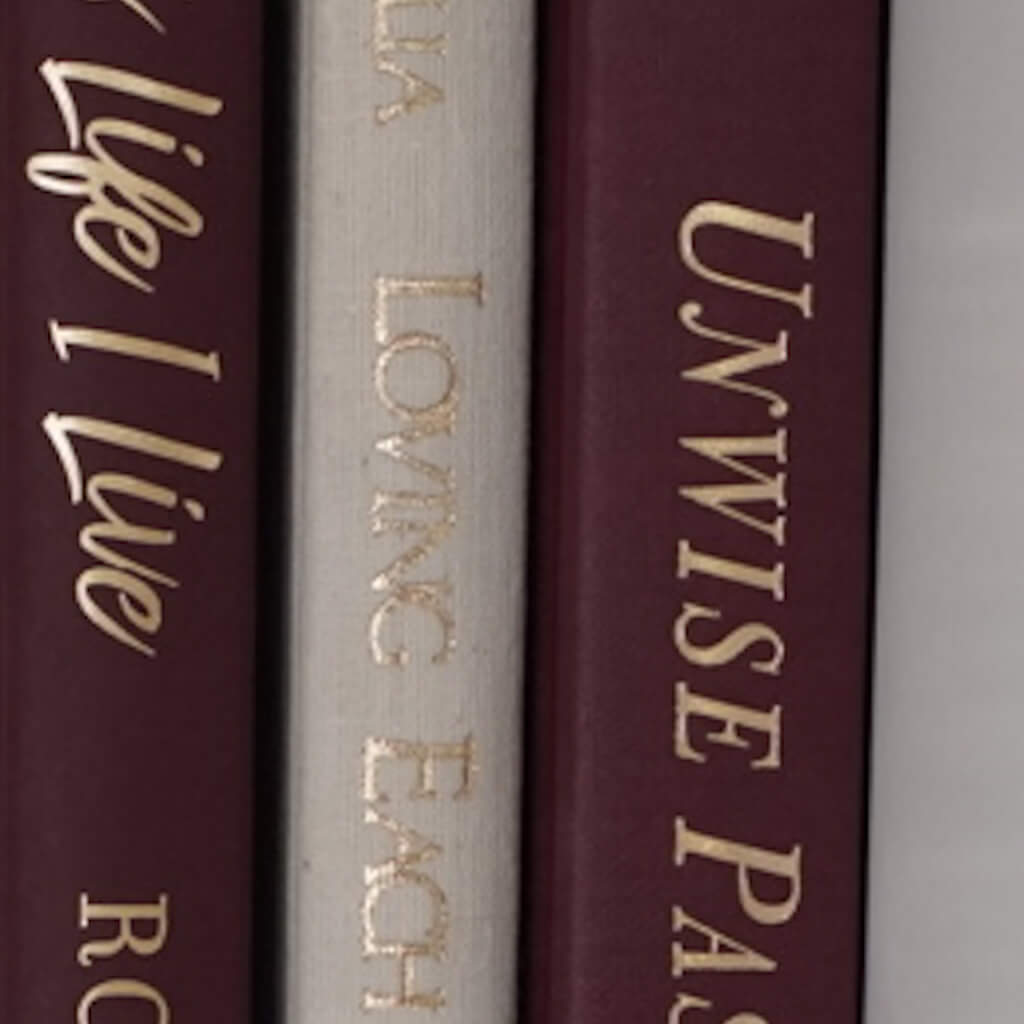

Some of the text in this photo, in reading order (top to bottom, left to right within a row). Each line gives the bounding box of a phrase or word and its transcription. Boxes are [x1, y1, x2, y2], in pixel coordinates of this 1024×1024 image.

[26, 58, 223, 655] Life I Live
[371, 272, 484, 668] LOVING
[674, 201, 814, 769] UNWISE
[361, 733, 478, 1014] EACH
